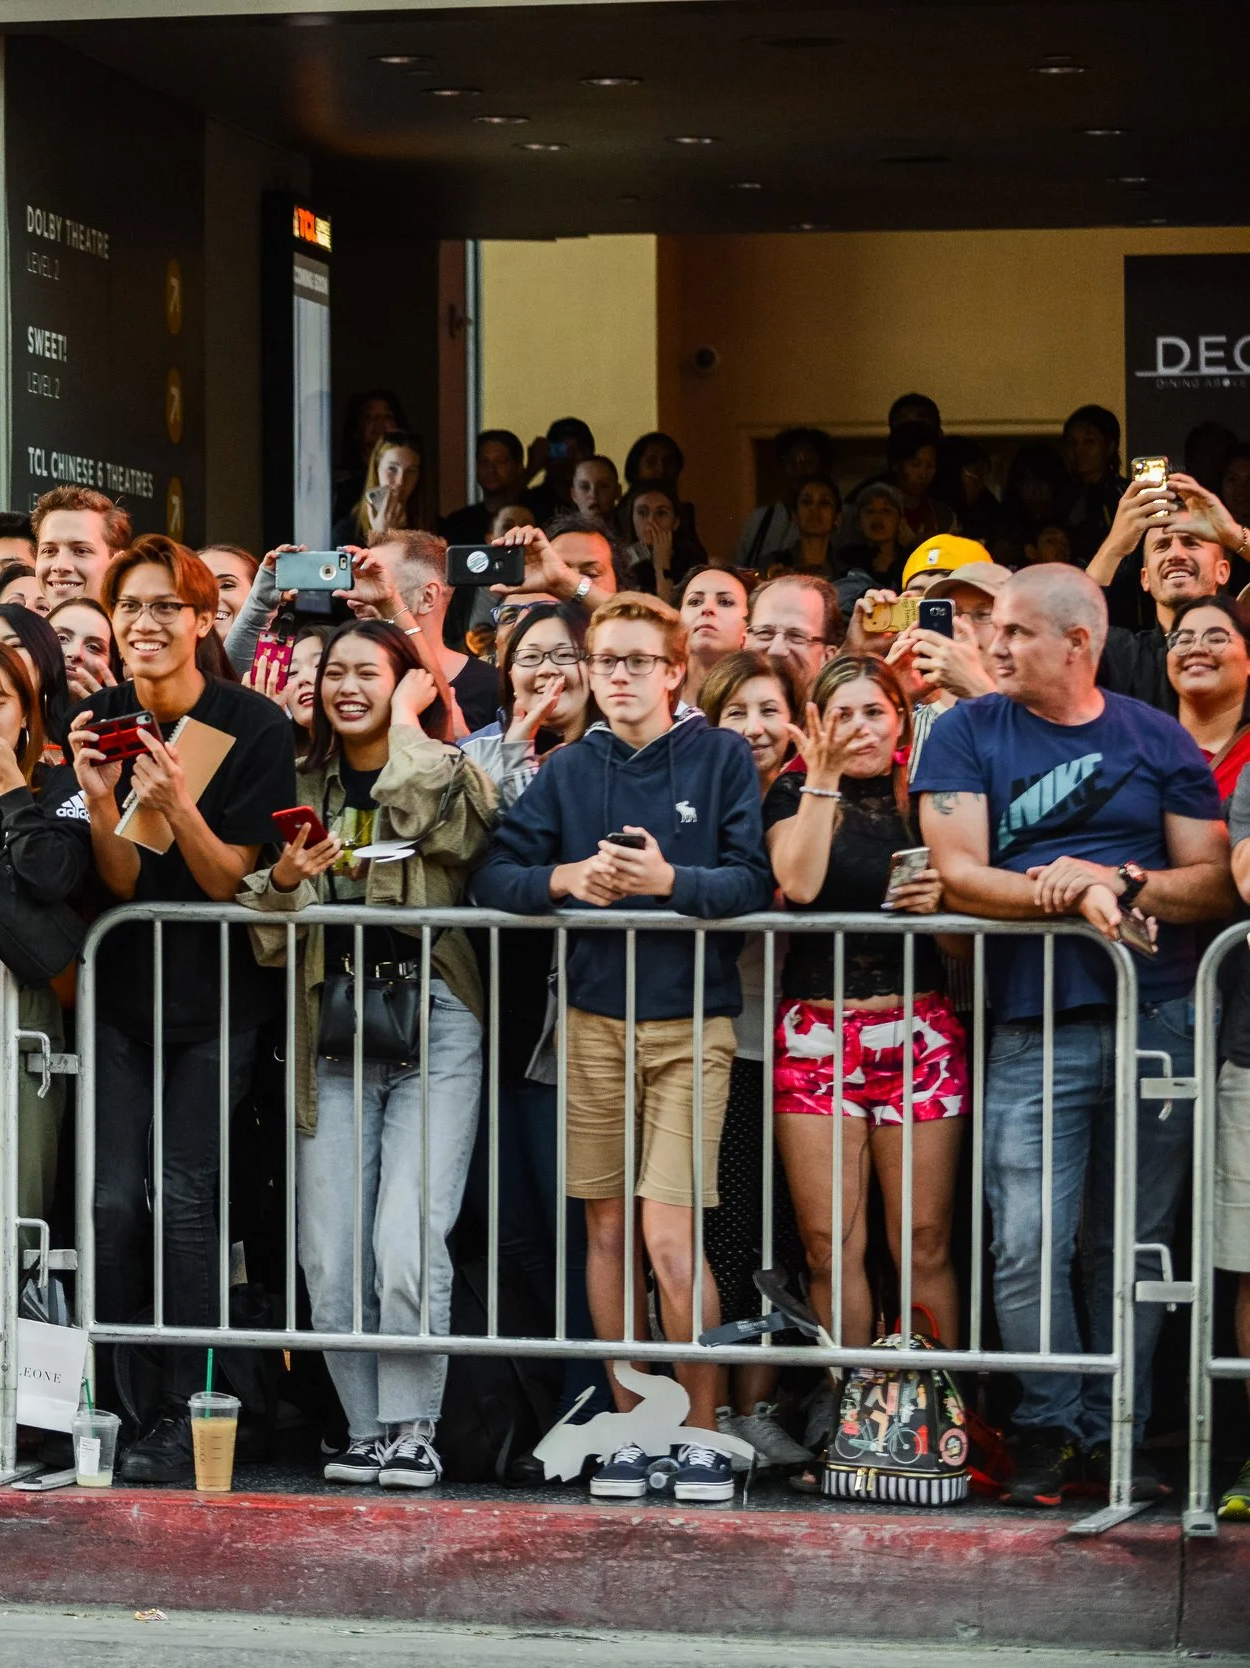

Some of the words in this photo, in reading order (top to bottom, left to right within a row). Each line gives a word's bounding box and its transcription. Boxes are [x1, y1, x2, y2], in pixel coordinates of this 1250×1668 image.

[26, 204, 62, 242] DOLBY
[65, 218, 110, 259] THEATRE
[27, 251, 52, 278] LEVEL
[27, 325, 67, 362] SWEET!
[27, 371, 52, 397] LEVEL
[27, 446, 48, 477] TCL
[50, 451, 94, 485] CHINESE
[96, 461, 104, 488] 6
[105, 462, 154, 499] THEATRES
[1008, 753, 1105, 832] NIKE
[55, 807, 91, 823] adid
[18, 1366, 62, 1384] EONE
